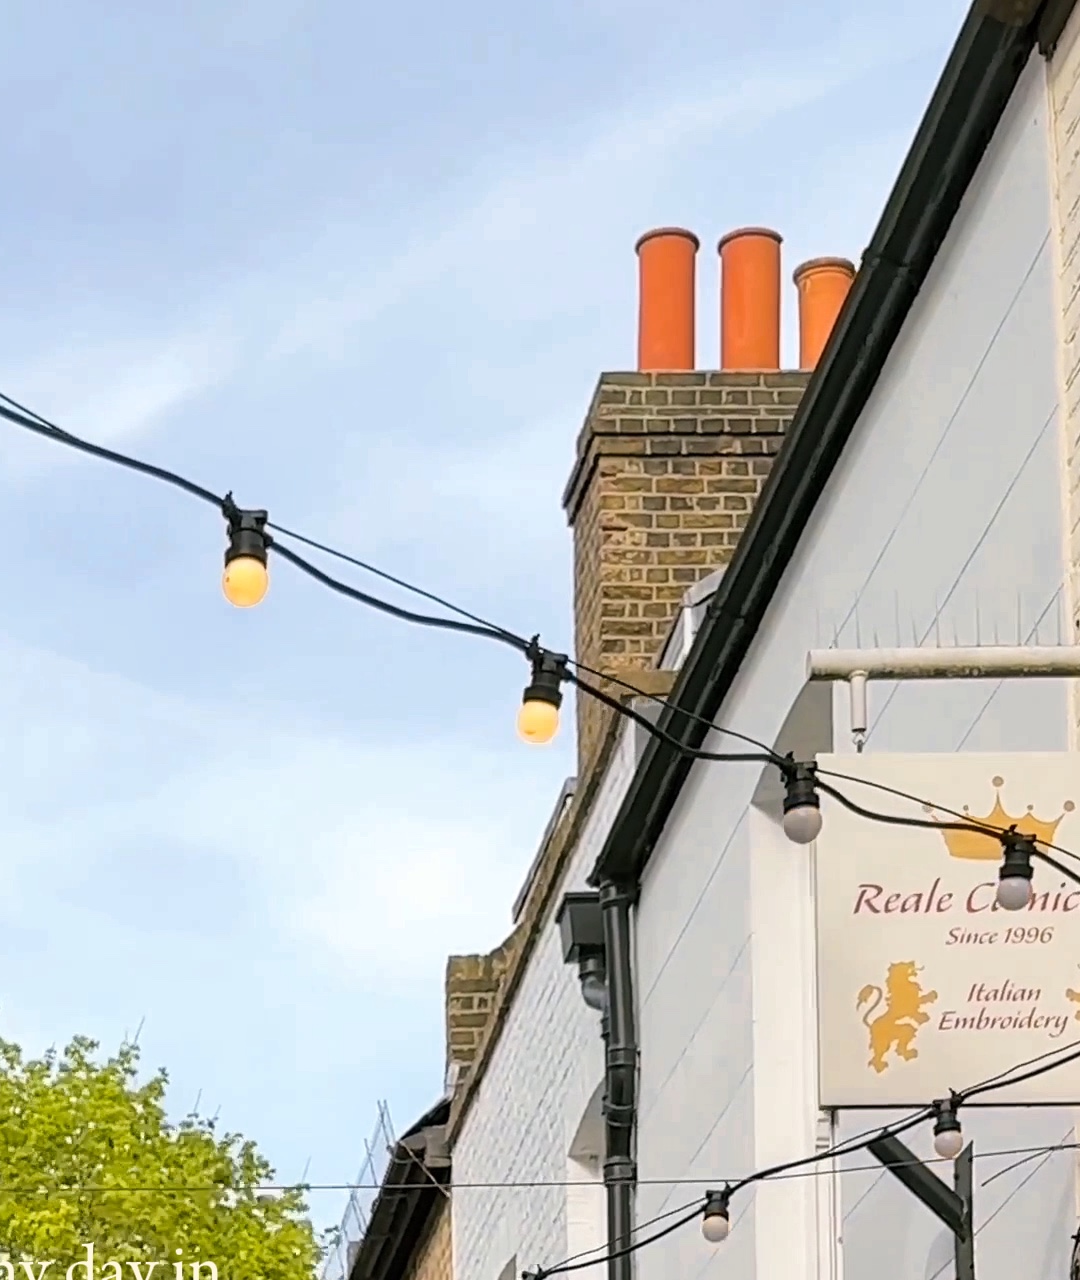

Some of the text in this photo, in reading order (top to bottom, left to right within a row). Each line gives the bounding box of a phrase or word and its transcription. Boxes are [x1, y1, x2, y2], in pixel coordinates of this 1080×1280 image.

[853, 878, 953, 915] Reale
[945, 927, 1054, 945] Since 1996
[967, 979, 1041, 1002] Italian
[938, 1008, 1069, 1038] Embroidery
